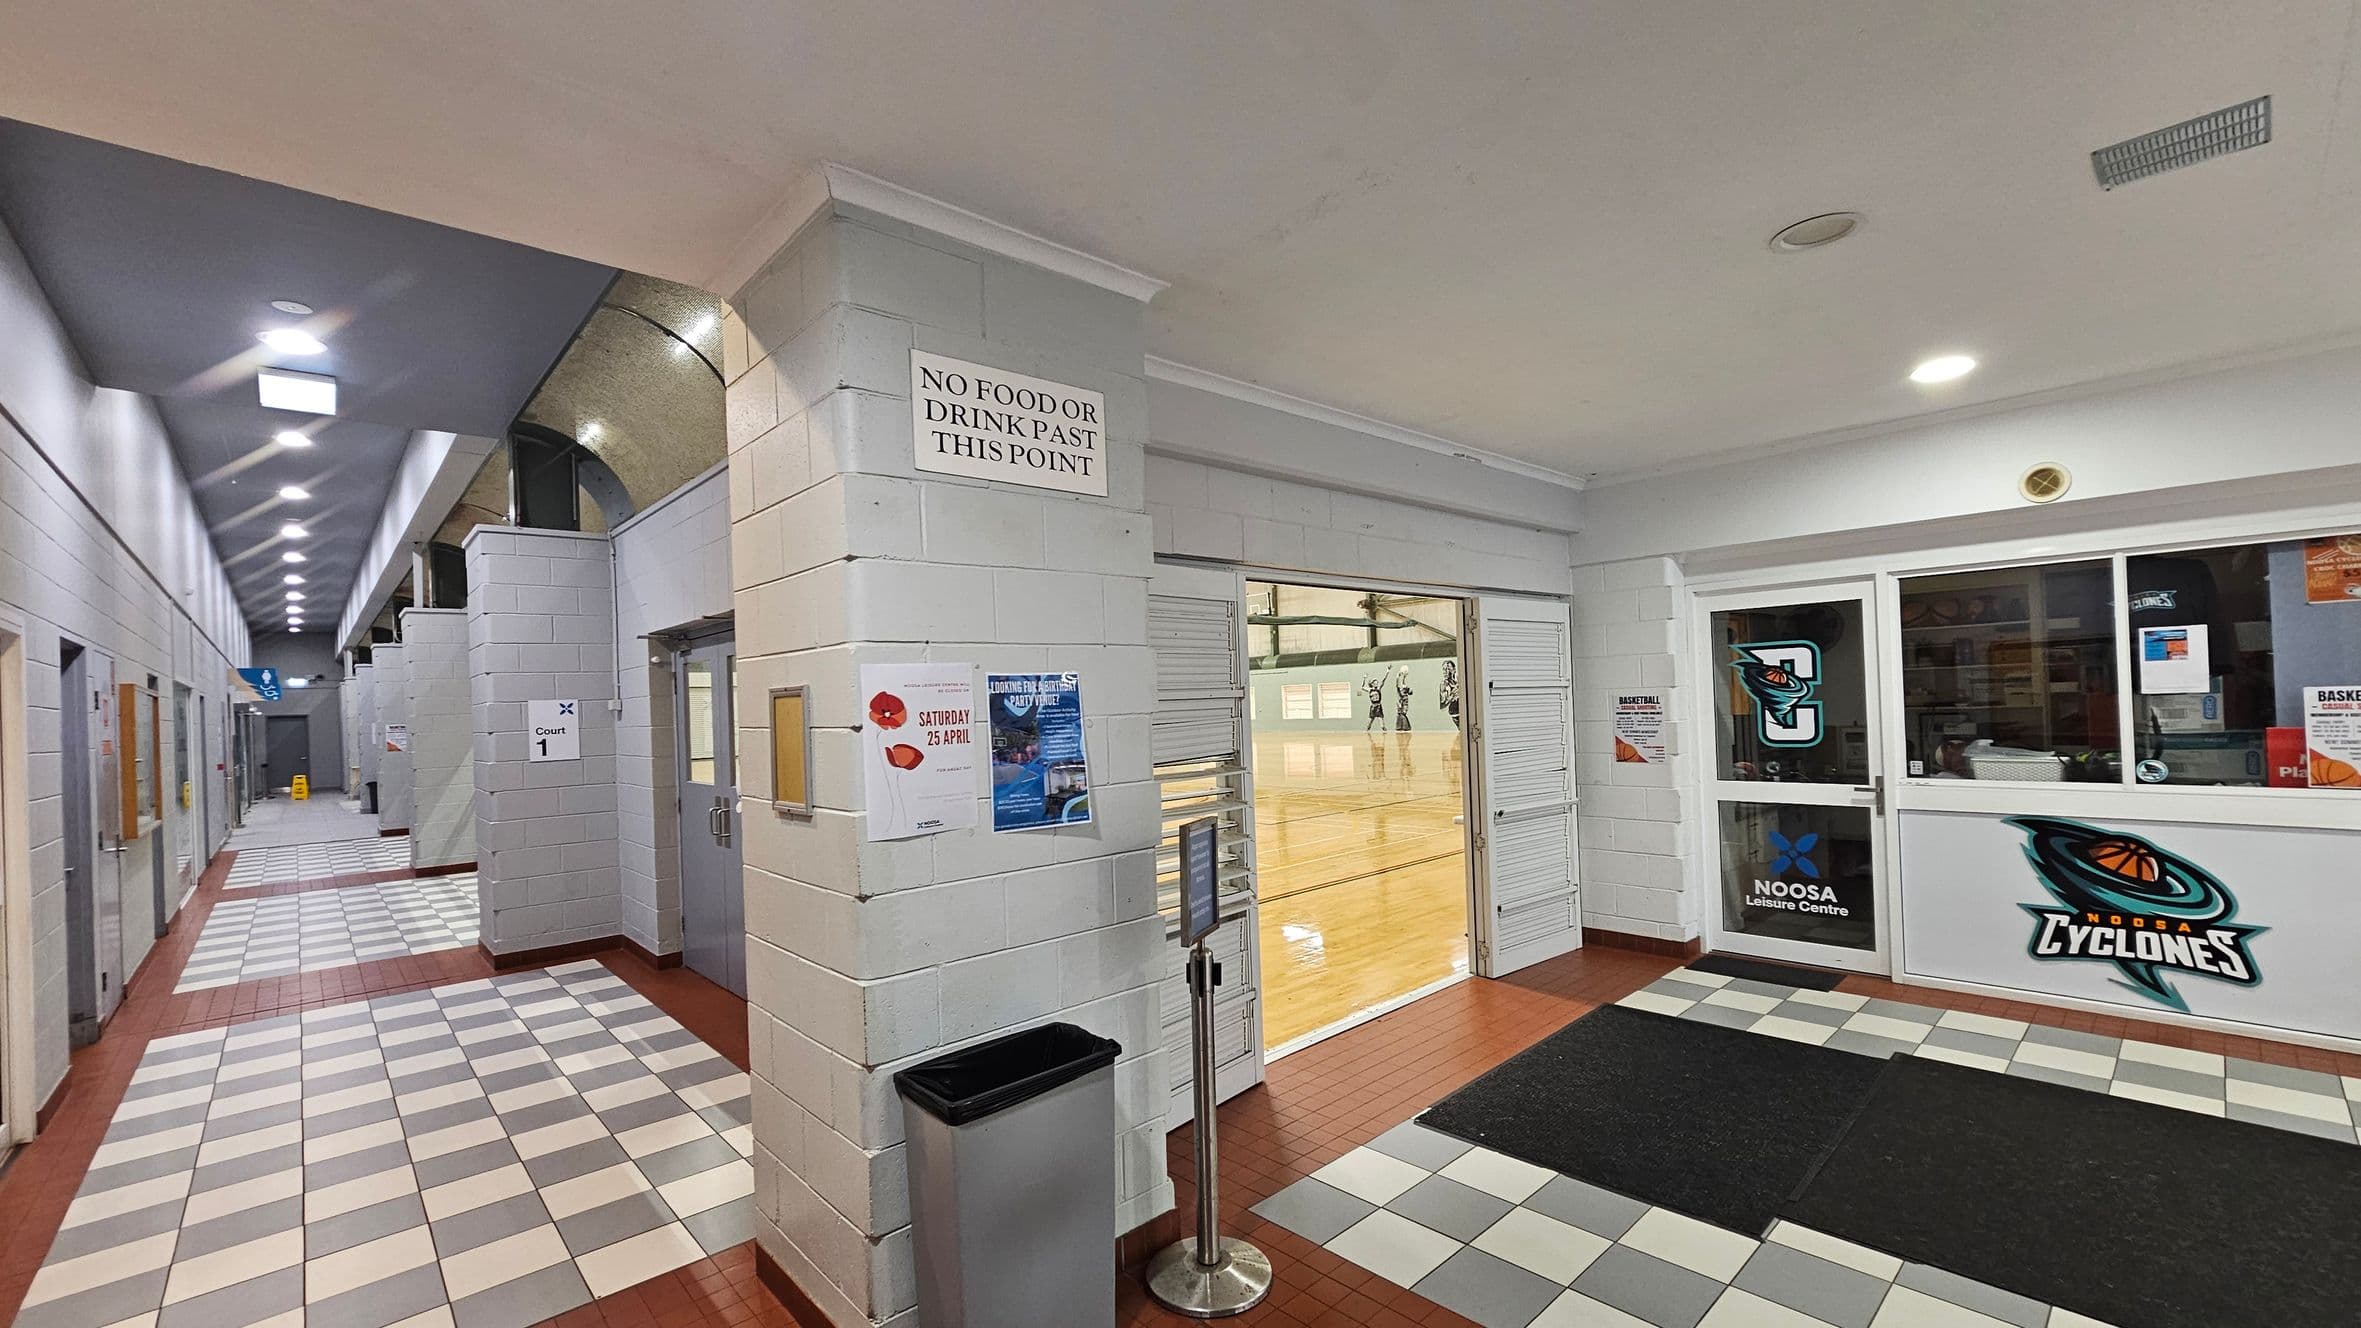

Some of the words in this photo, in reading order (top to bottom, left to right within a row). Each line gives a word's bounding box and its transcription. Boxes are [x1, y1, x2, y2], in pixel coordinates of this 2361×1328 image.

[920, 366, 968, 396] NO
[975, 378, 1057, 414] FOOD
[1062, 399, 1098, 424] OR
[924, 398, 1026, 438] DRINK
[1032, 419, 1098, 450] PAST
[931, 430, 1003, 462] THIS
[1008, 443, 1094, 476] POINT
[991, 681, 1023, 694] LOOKING
[1024, 681, 1037, 692] FOR
[1010, 695, 1033, 707] PARTY
[1034, 694, 1059, 706] VENUE?
[1619, 696, 1660, 705] BASKETBALL
[919, 710, 970, 727] SATURDAY
[536, 727, 566, 736] Court
[928, 731, 940, 746] 25
[944, 729, 971, 745] APRIL
[536, 738, 547, 756] 1
[1754, 880, 1838, 902] NOOSA
[1746, 895, 1796, 910] Leisure
[1799, 901, 1849, 916] Centre
[2087, 912, 2192, 933] NOOSA
[2037, 914, 2250, 980] CYCLONES
